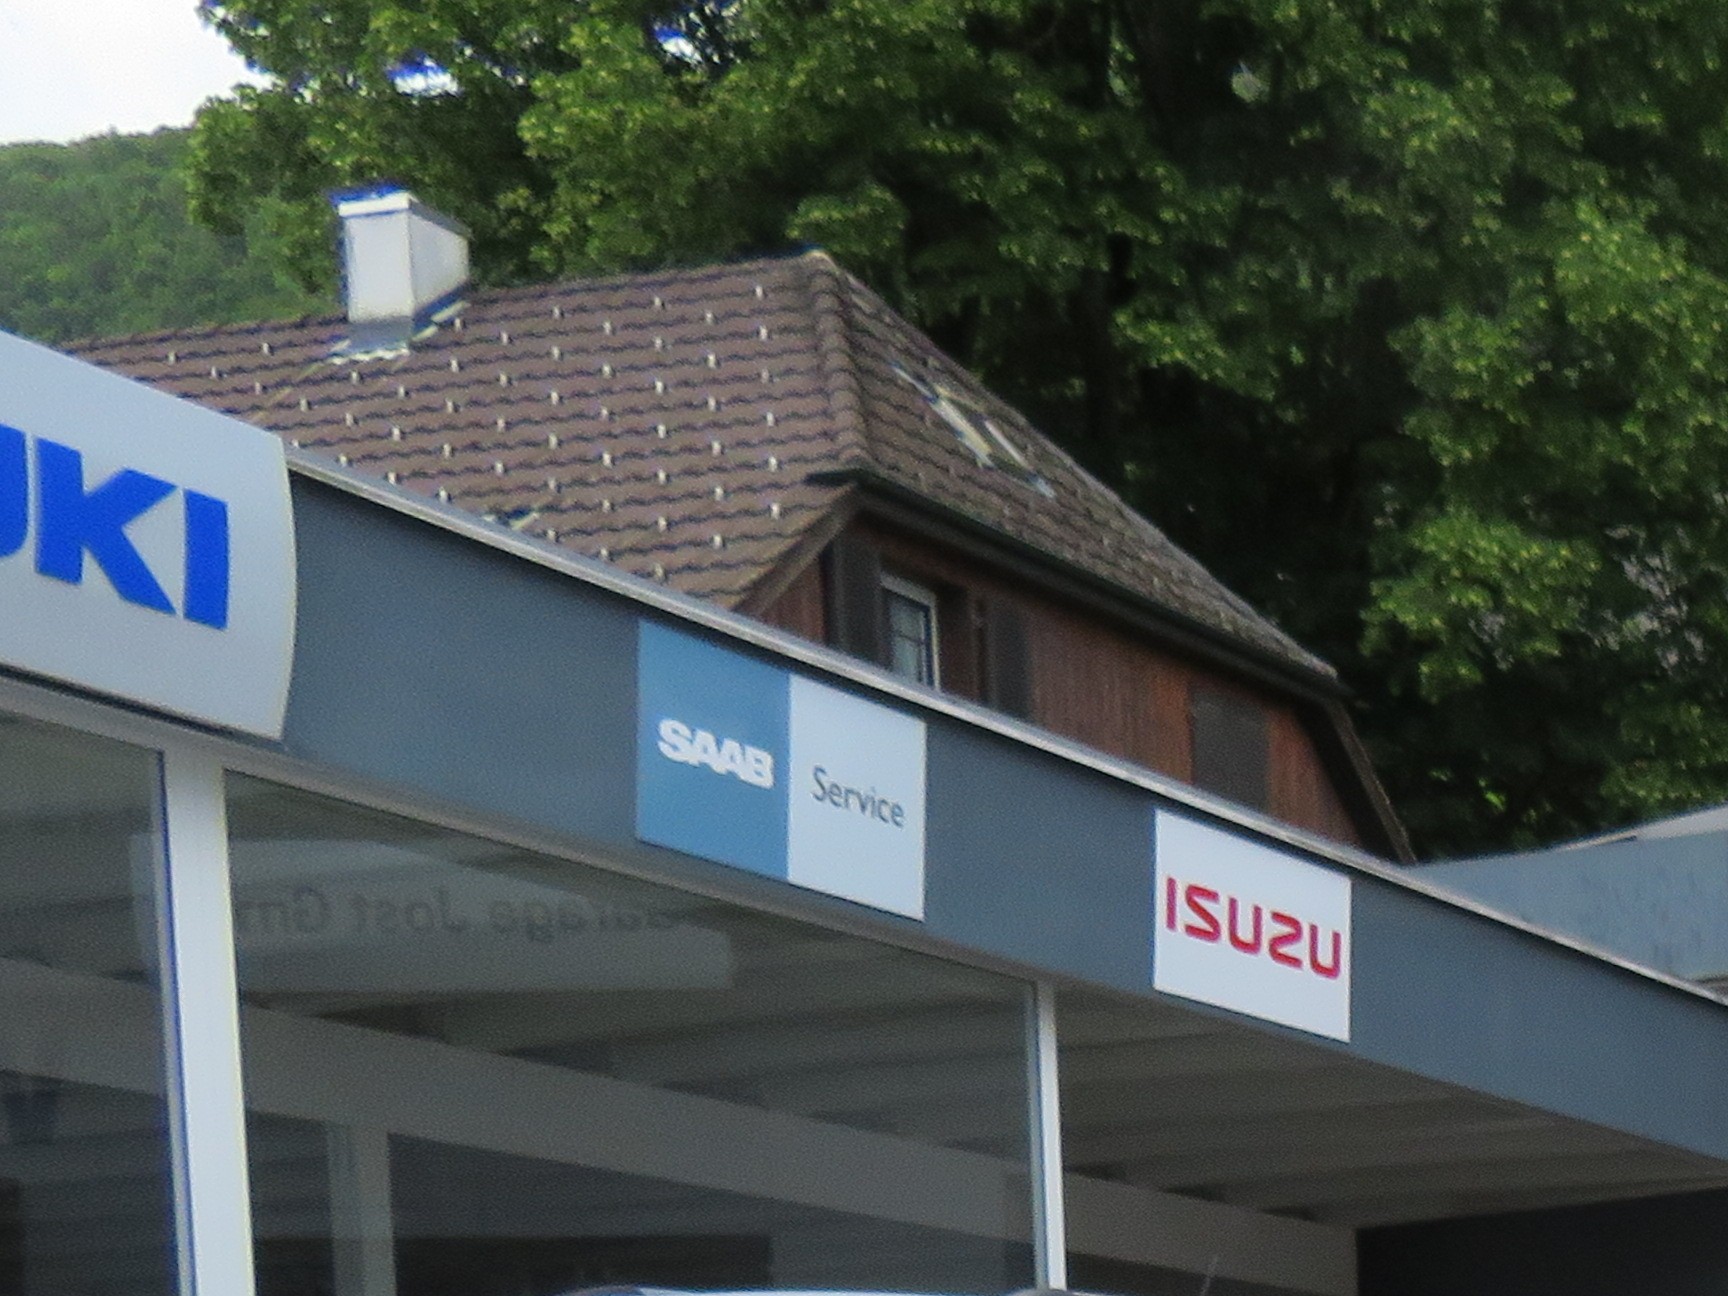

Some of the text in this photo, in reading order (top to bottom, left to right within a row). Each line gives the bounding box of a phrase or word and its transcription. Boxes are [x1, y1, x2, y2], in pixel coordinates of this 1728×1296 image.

[657, 719, 774, 790] SAAB
[811, 765, 906, 828] Service
[1165, 876, 1343, 980] ISUZU
